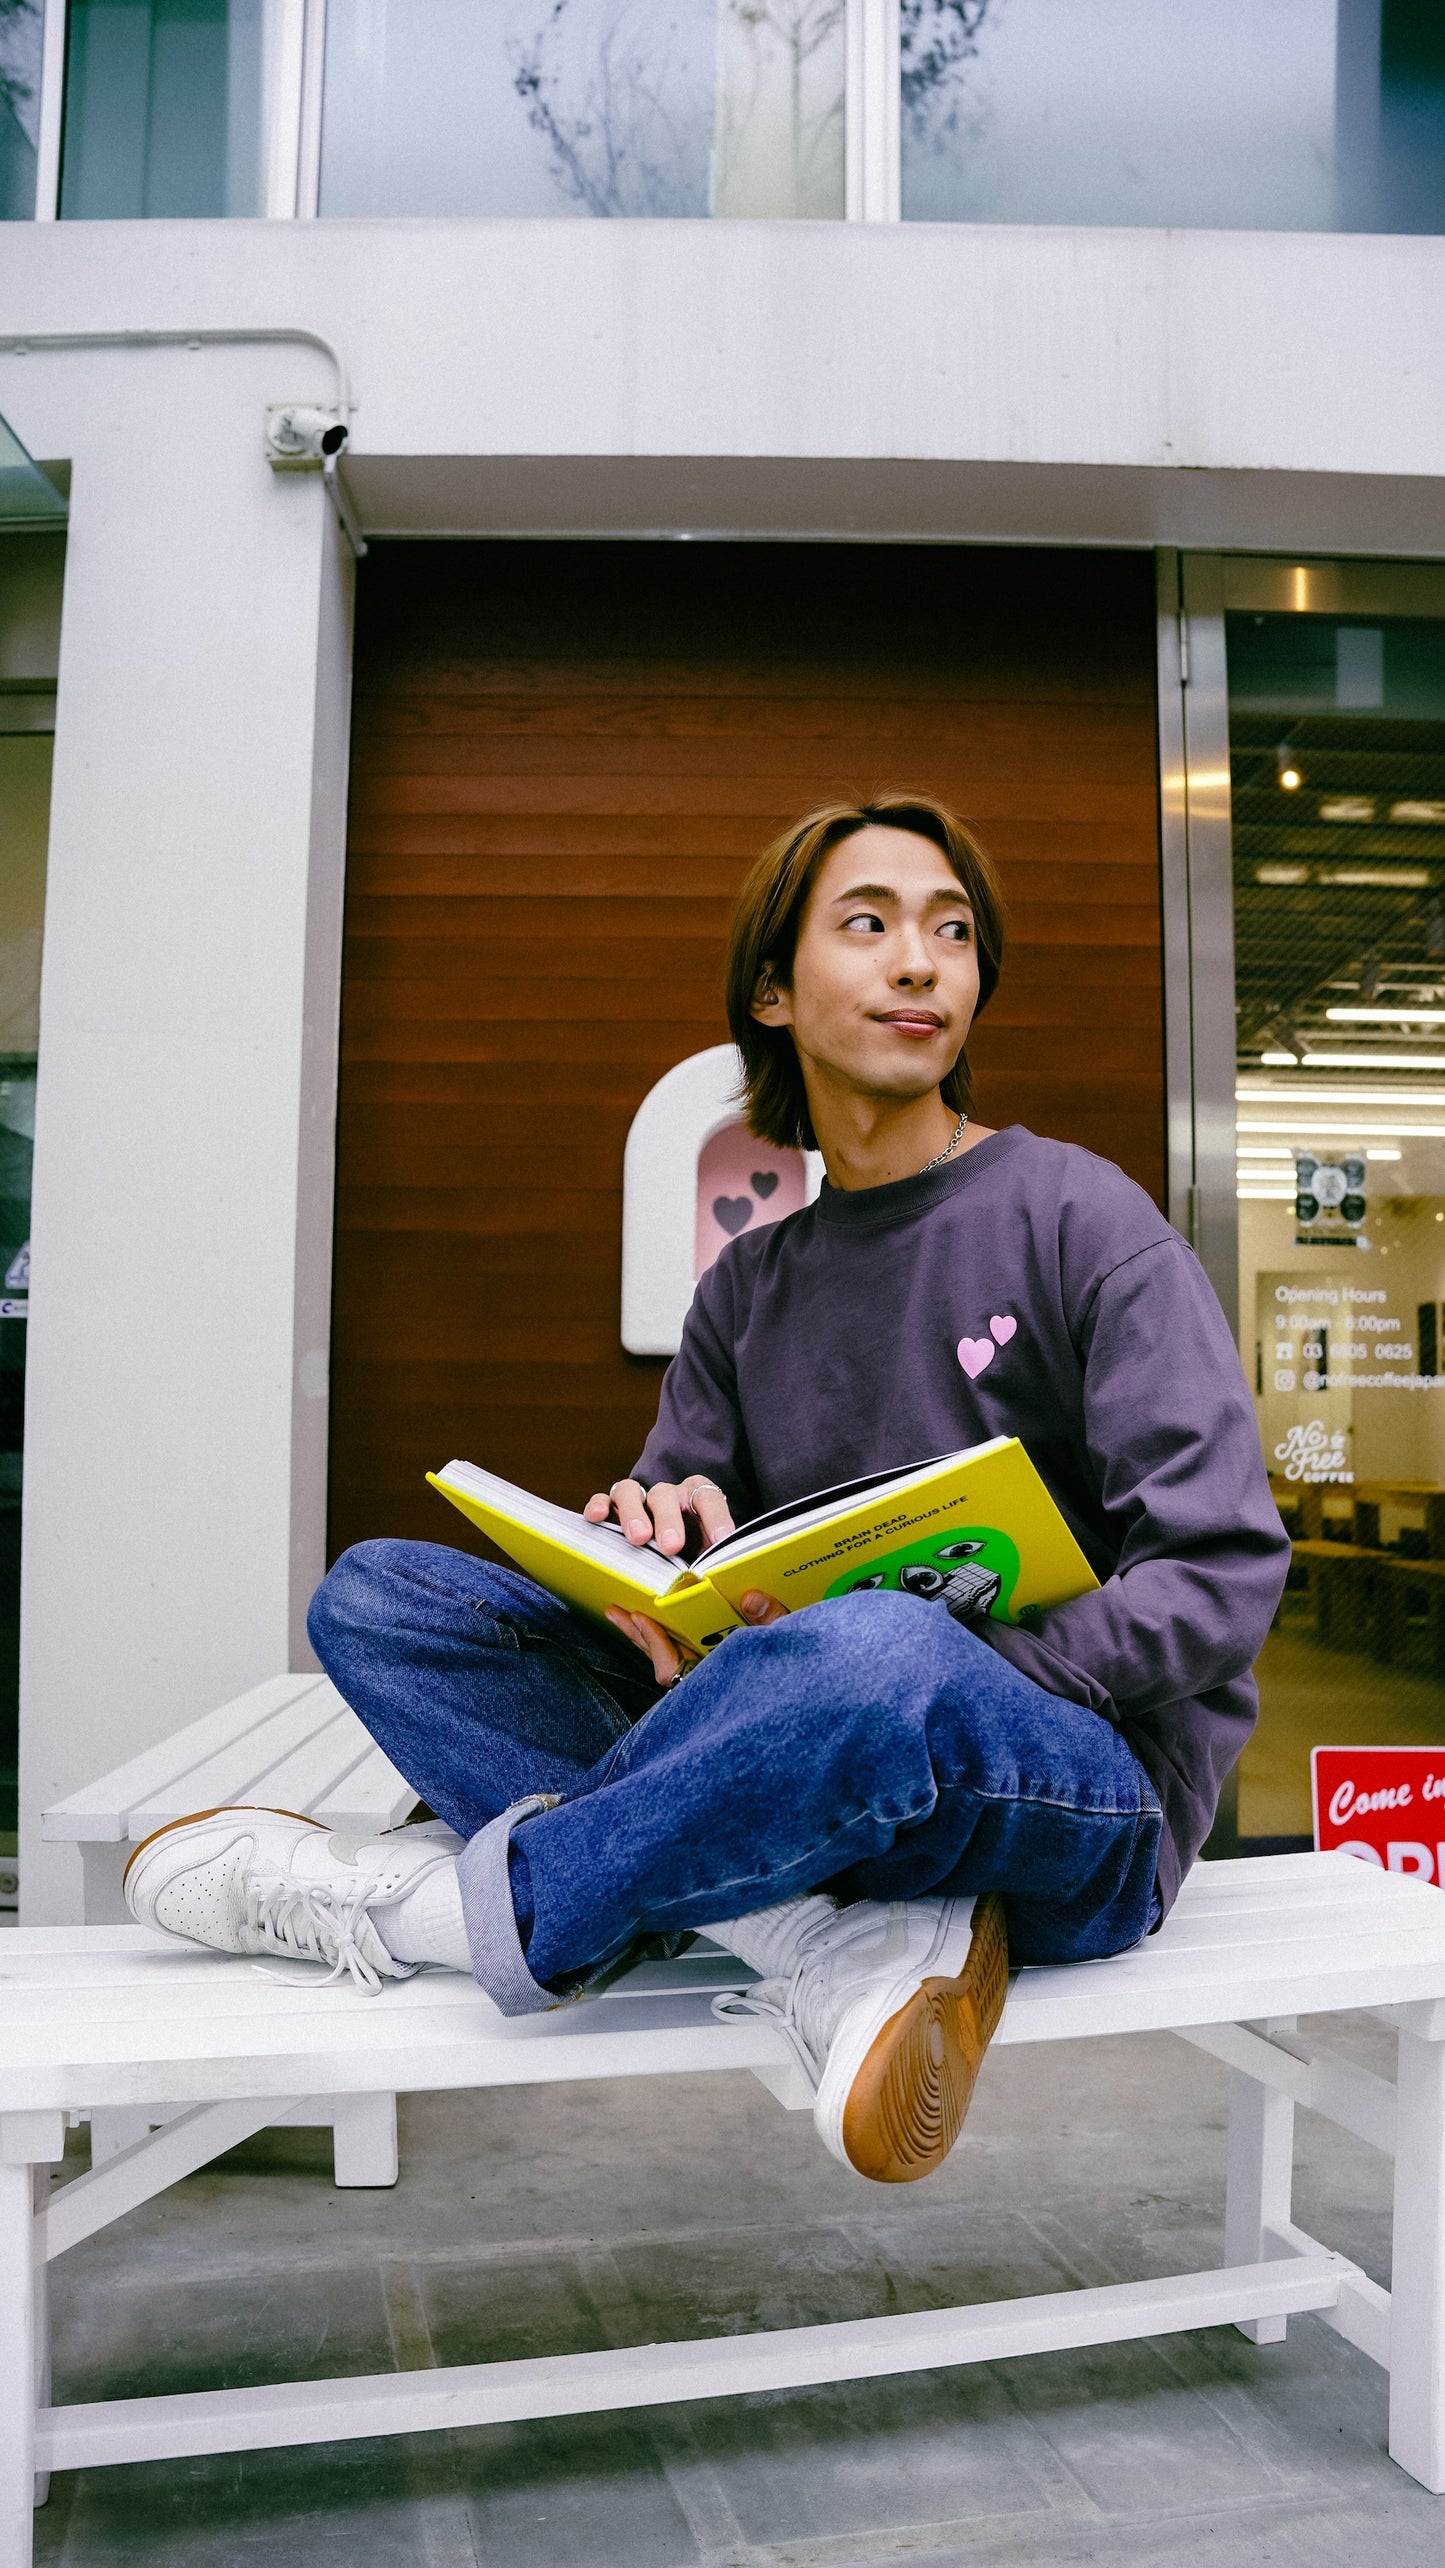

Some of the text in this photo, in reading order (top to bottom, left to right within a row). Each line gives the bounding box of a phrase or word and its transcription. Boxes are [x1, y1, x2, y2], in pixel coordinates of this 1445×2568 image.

[1275, 1286, 1387, 1305] Opening Hours
[1303, 1342, 1323, 1360] 03
[1274, 1420, 1328, 1460] No
[1284, 1447, 1346, 1481] Free
[1302, 1472, 1354, 1484] COFFEE
[783, 1549, 845, 1577] CLOTHING
[846, 1538, 872, 1551] FOR
[885, 1508, 940, 1535] CURIOUS
[942, 1495, 968, 1510] LIFE
[834, 1514, 907, 1548] BRAIN DEAD
[1329, 1780, 1413, 1826] Come
